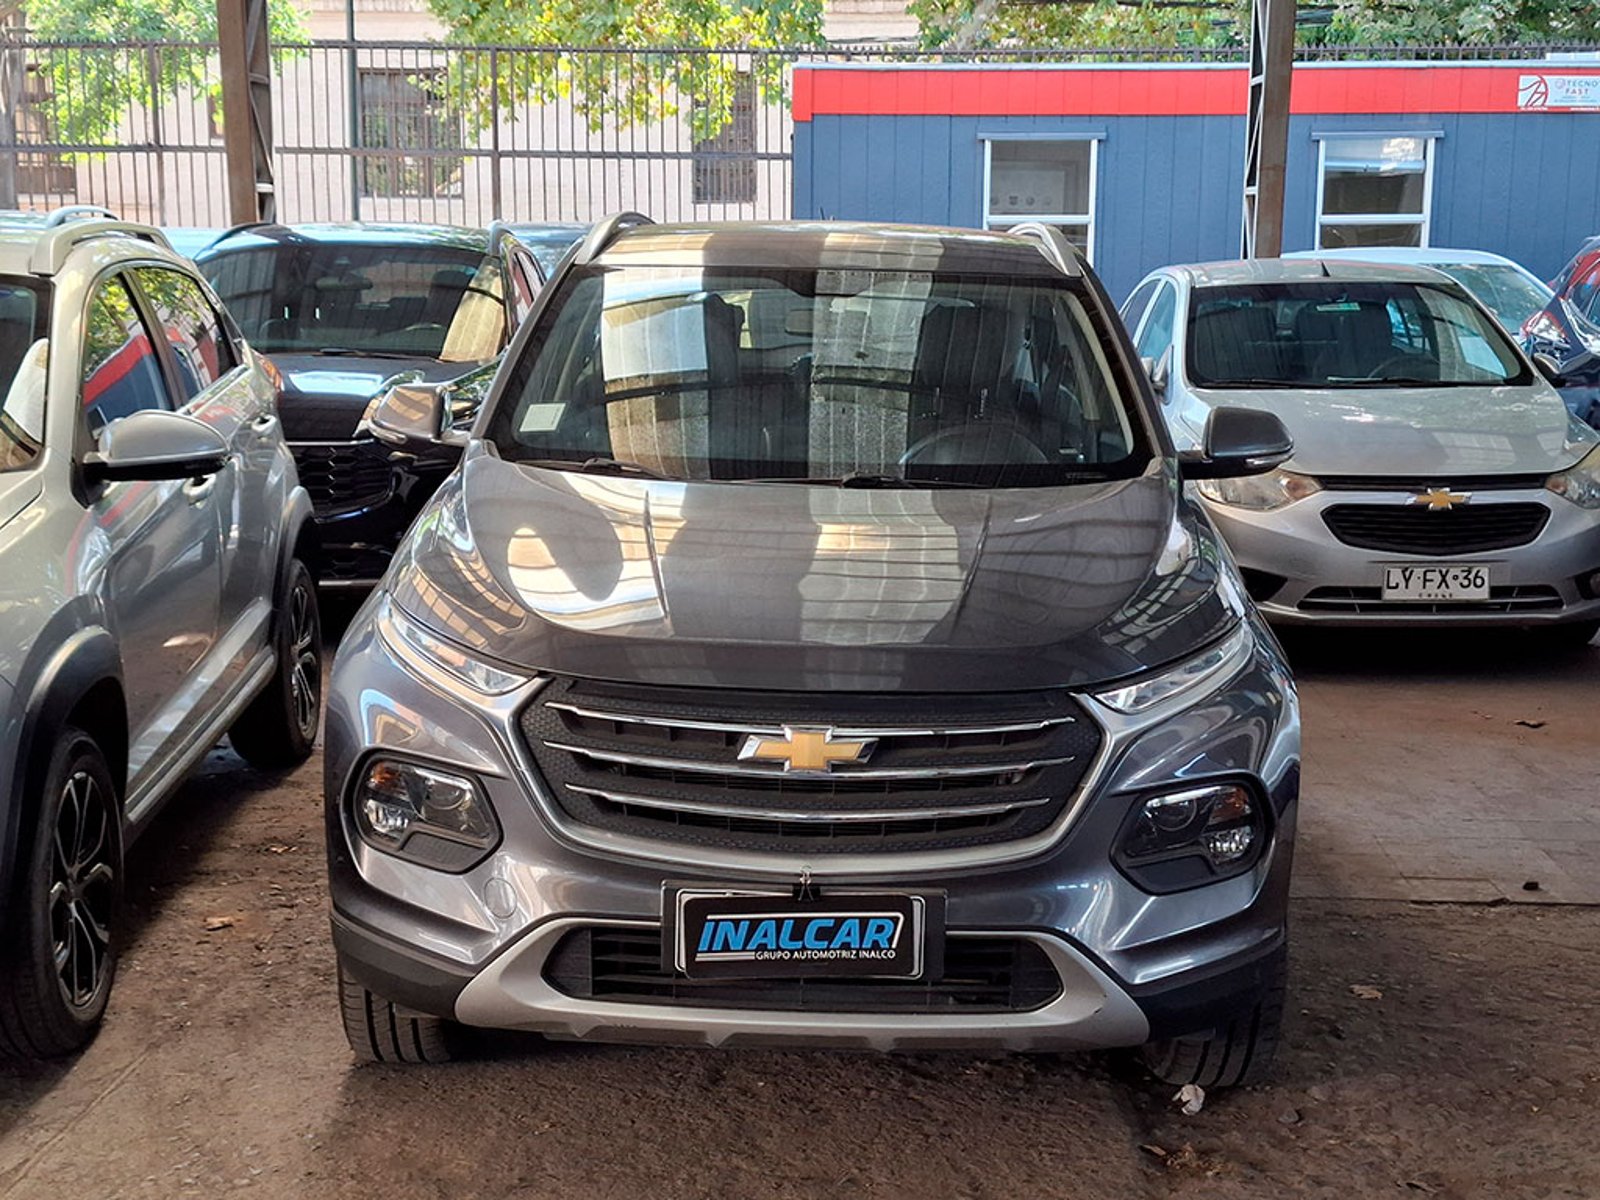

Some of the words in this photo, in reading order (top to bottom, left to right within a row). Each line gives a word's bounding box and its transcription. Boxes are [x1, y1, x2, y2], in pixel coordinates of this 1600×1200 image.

[1567, 80, 1598, 88] TECNO
[698, 918, 895, 951] INALCAR
[755, 951, 791, 961] GRUPO
[792, 950, 857, 960] AUTOMOTRIZ
[858, 949, 896, 959] INALCO
